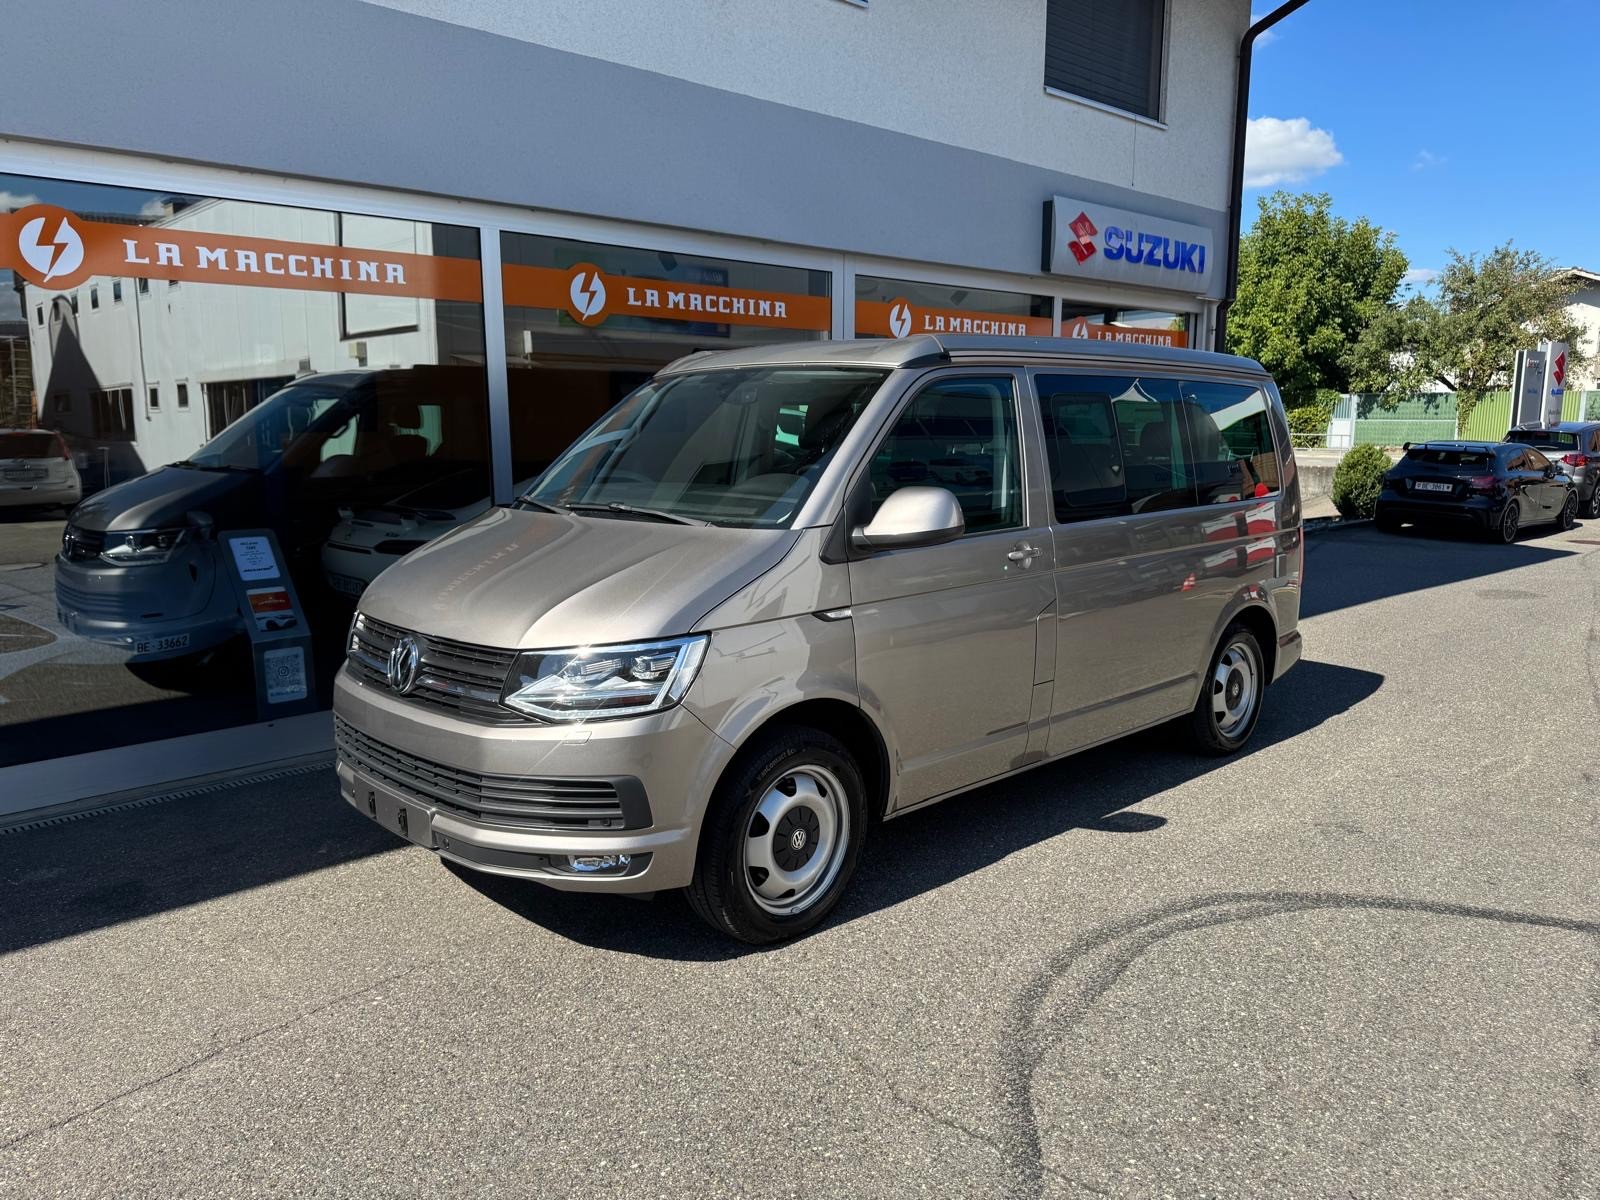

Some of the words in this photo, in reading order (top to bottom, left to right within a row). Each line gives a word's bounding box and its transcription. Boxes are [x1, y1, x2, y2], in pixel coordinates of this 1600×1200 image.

[122, 238, 184, 267] LA
[196, 245, 407, 285] MACCHINA
[1103, 226, 1206, 274] SUZUKI
[626, 287, 661, 308] LA
[666, 290, 788, 318] MACCHINA
[923, 314, 945, 332] LA
[948, 316, 1027, 336] MACCHINA
[1115, 332, 1172, 347] MACCHINA
[157, 635, 188, 650] 33662
